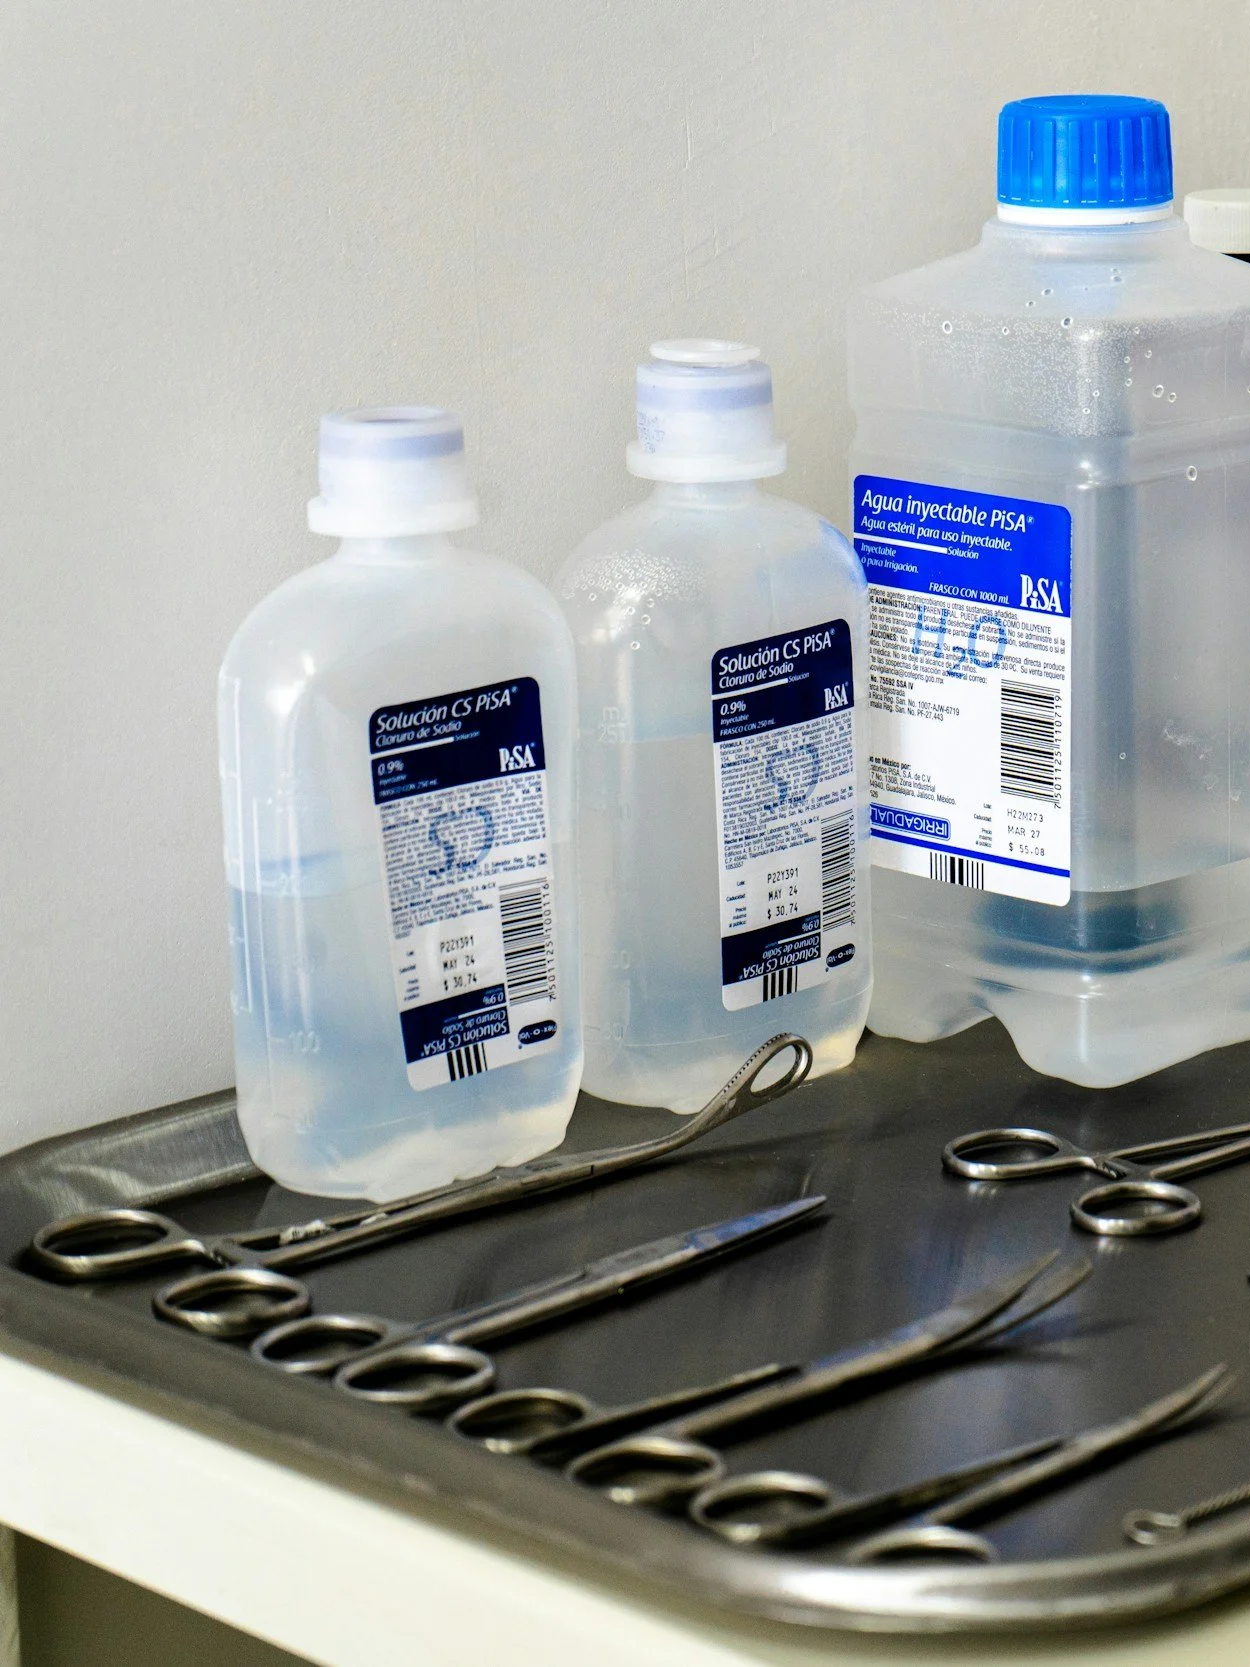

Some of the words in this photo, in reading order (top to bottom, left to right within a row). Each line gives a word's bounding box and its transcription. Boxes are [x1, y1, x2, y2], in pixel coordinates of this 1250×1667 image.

[861, 489, 903, 515] Agua
[906, 495, 987, 527] inyectable
[861, 516, 886, 531] Agua
[888, 520, 916, 535] estéril
[917, 525, 940, 540] para
[941, 531, 959, 543] uso
[960, 532, 1012, 552] inyectable.
[861, 542, 897, 558] Inyectable
[947, 545, 979, 560] Solución
[867, 558, 884, 569] para
[929, 582, 960, 596] FRASCO
[960, 587, 979, 599] CON
[979, 591, 998, 603] 1000
[719, 646, 780, 676] Solución
[782, 638, 801, 660] CS
[719, 671, 755, 689] Cloruro
[756, 668, 768, 681] de
[768, 662, 794, 678] Sodio
[376, 704, 448, 734] Solución
[451, 696, 474, 718] CS
[720, 699, 747, 716] 0.9%
[375, 730, 415, 748] Cloruro
[416, 727, 431, 739] de
[872, 808, 948, 838] IRRIGADUAL
[1007, 825, 1026, 837] MAR
[1031, 829, 1041, 839] 27
[1008, 842, 1014, 852] $
[1018, 844, 1045, 857] 55.08
[768, 888, 783, 902] MAY
[789, 885, 798, 897] 24
[766, 958, 779, 971] CS
[779, 944, 820, 966] Solución
[448, 1032, 461, 1048] CS
[462, 1020, 507, 1042] Solución
